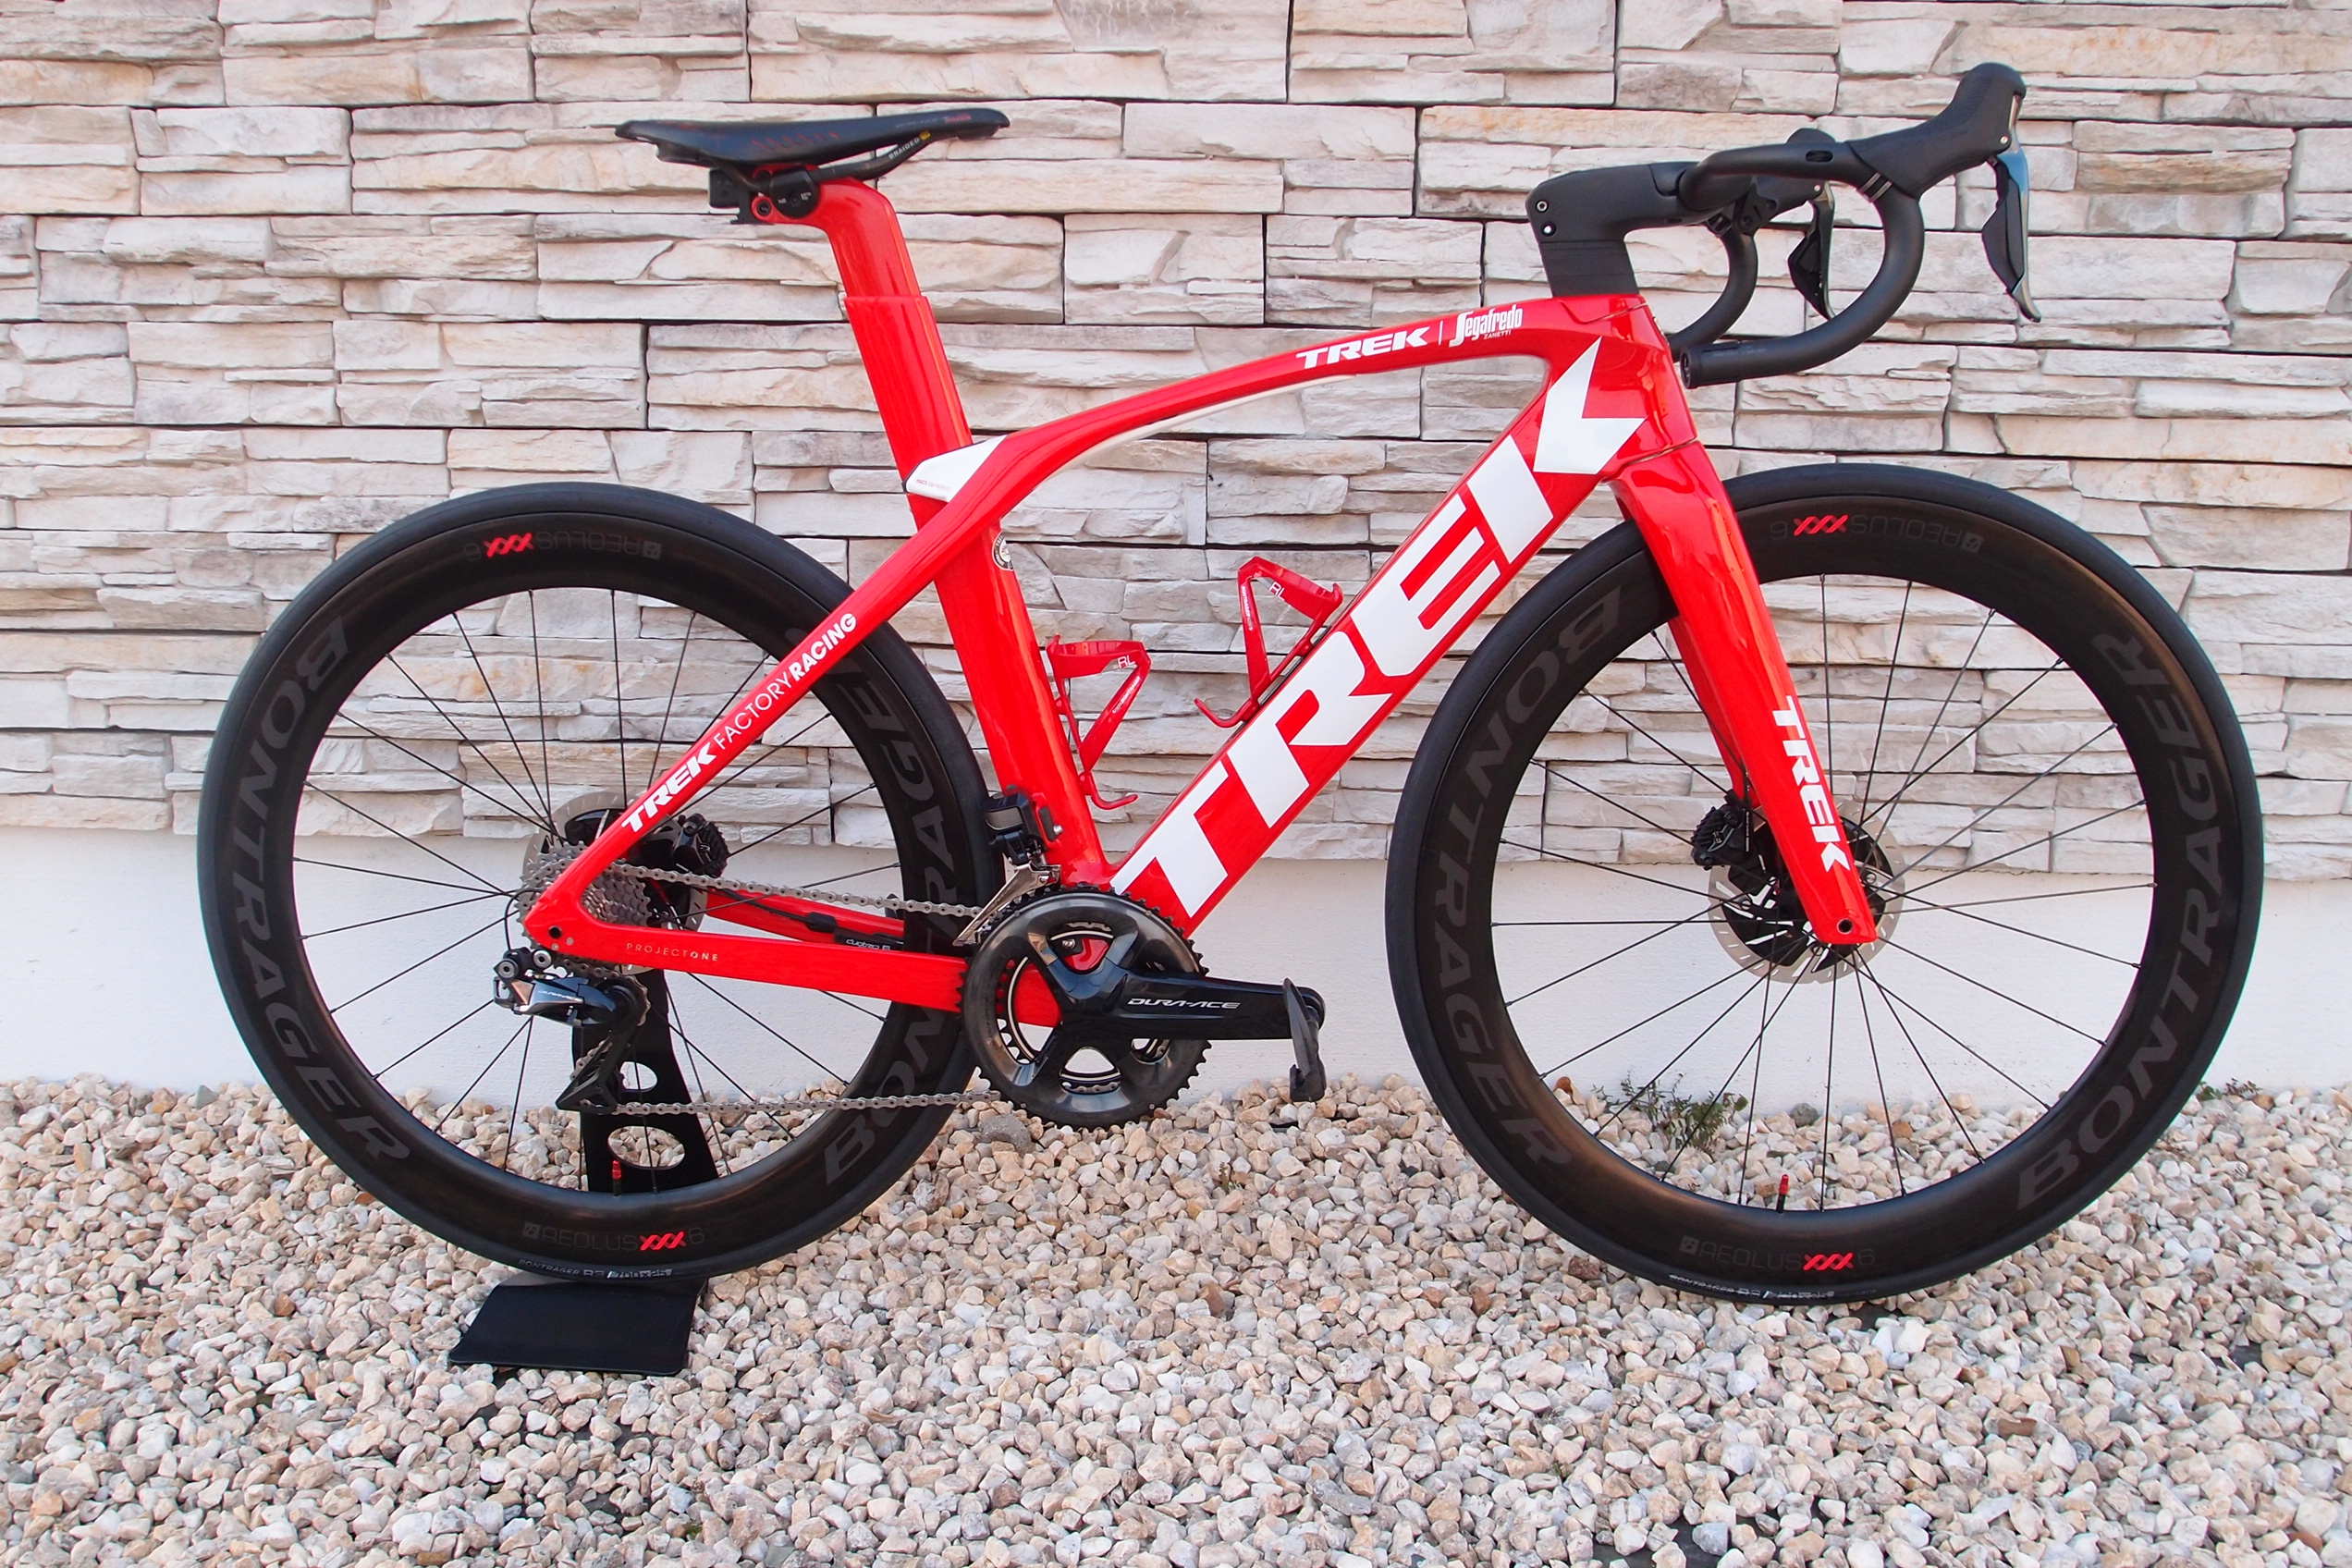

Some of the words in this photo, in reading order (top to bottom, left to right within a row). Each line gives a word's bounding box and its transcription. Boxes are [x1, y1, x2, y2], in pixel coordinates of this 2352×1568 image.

[1295, 326, 1430, 369] TREK
[1448, 304, 1524, 348] Segafredo
[1483, 329, 1512, 340] ZANETTI
[535, 531, 642, 556] AEOLUS
[1850, 514, 1963, 546] AEOLUS
[1109, 337, 1646, 918] TREK
[620, 742, 717, 832] TREK
[713, 671, 792, 750] FACTORY
[789, 613, 857, 681] RACING
[1771, 695, 1851, 872] TREK
[231, 615, 410, 1161] BONTRAGER
[1434, 584, 1622, 1166] BONTRAGER
[2017, 633, 2223, 1211] BONTRAGER
[1127, 998, 1241, 1010] DURA-ACE
[541, 1227, 639, 1250] AEOLUS
[688, 1227, 705, 1245] 6
[1698, 1241, 1803, 1271] AEOLUS
[1857, 1249, 1875, 1267] 6
